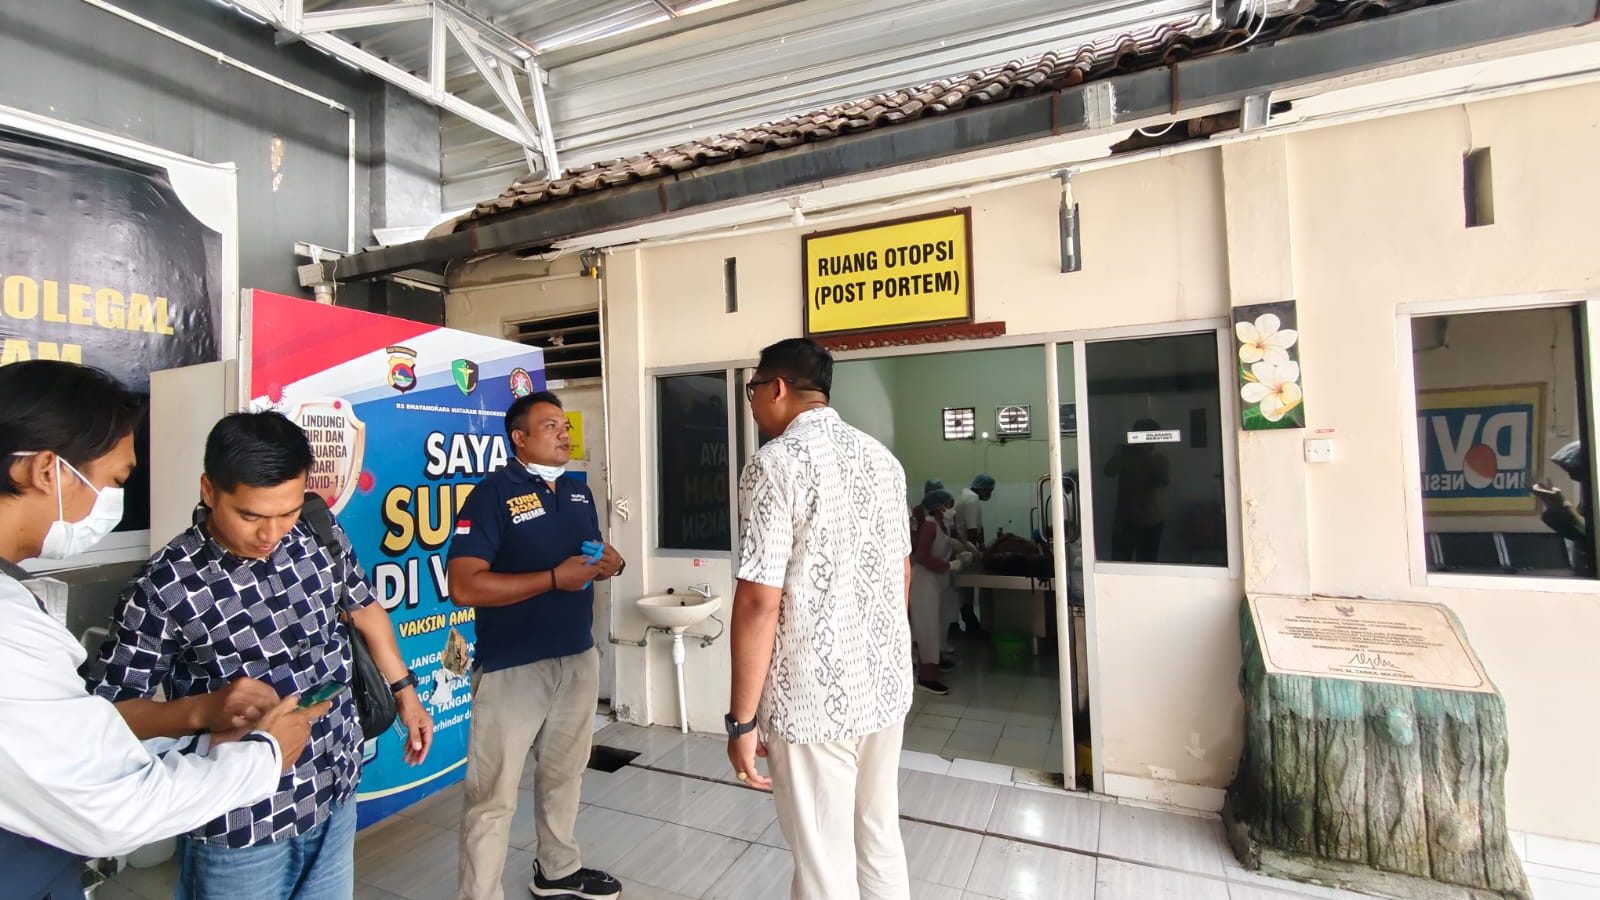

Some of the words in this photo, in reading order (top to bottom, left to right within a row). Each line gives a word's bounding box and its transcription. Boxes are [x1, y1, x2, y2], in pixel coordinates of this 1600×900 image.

[818, 251, 878, 277] RUANG
[884, 240, 954, 268] OTOPSI
[814, 281, 866, 310] (POST
[872, 270, 960, 300] PORTEM)
[0, 275, 174, 335] OLEGAL
[302, 414, 345, 428] LINDUNGI
[325, 430, 344, 443] DAN
[425, 431, 508, 476] SAYA
[313, 460, 335, 474] DARI
[506, 492, 539, 507] TURN
[512, 507, 546, 524] CRIME
[376, 559, 419, 610] DI
[399, 614, 446, 638] VAKSIN
